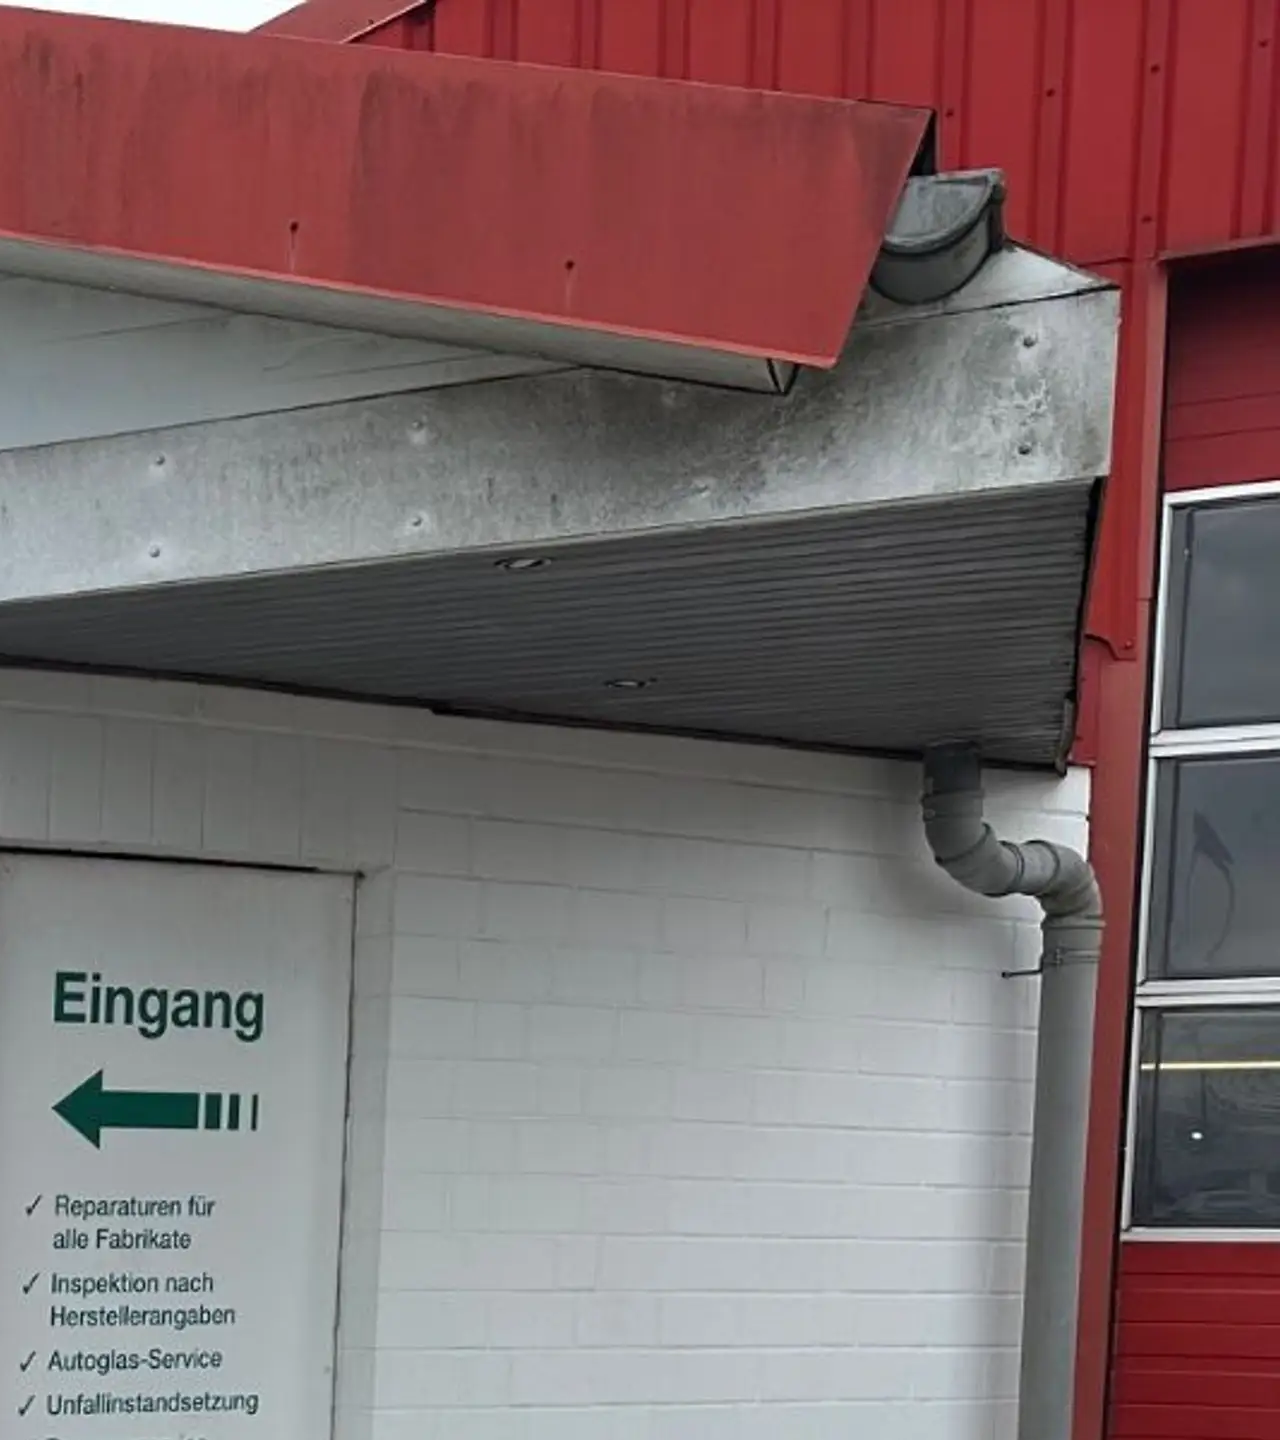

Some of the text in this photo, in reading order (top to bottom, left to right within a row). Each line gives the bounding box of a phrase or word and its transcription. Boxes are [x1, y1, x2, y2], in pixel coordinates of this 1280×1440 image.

[53, 970, 265, 1043] Eingang
[53, 1194, 216, 1220] Reparaturen für
[51, 1228, 192, 1250] alle Fabrikate
[50, 1272, 215, 1298] Inspektion nach
[49, 1305, 237, 1331] Herstellerangaben
[46, 1348, 223, 1376] Autoglas-Service
[45, 1392, 260, 1416] Unfallinstandsetzung
